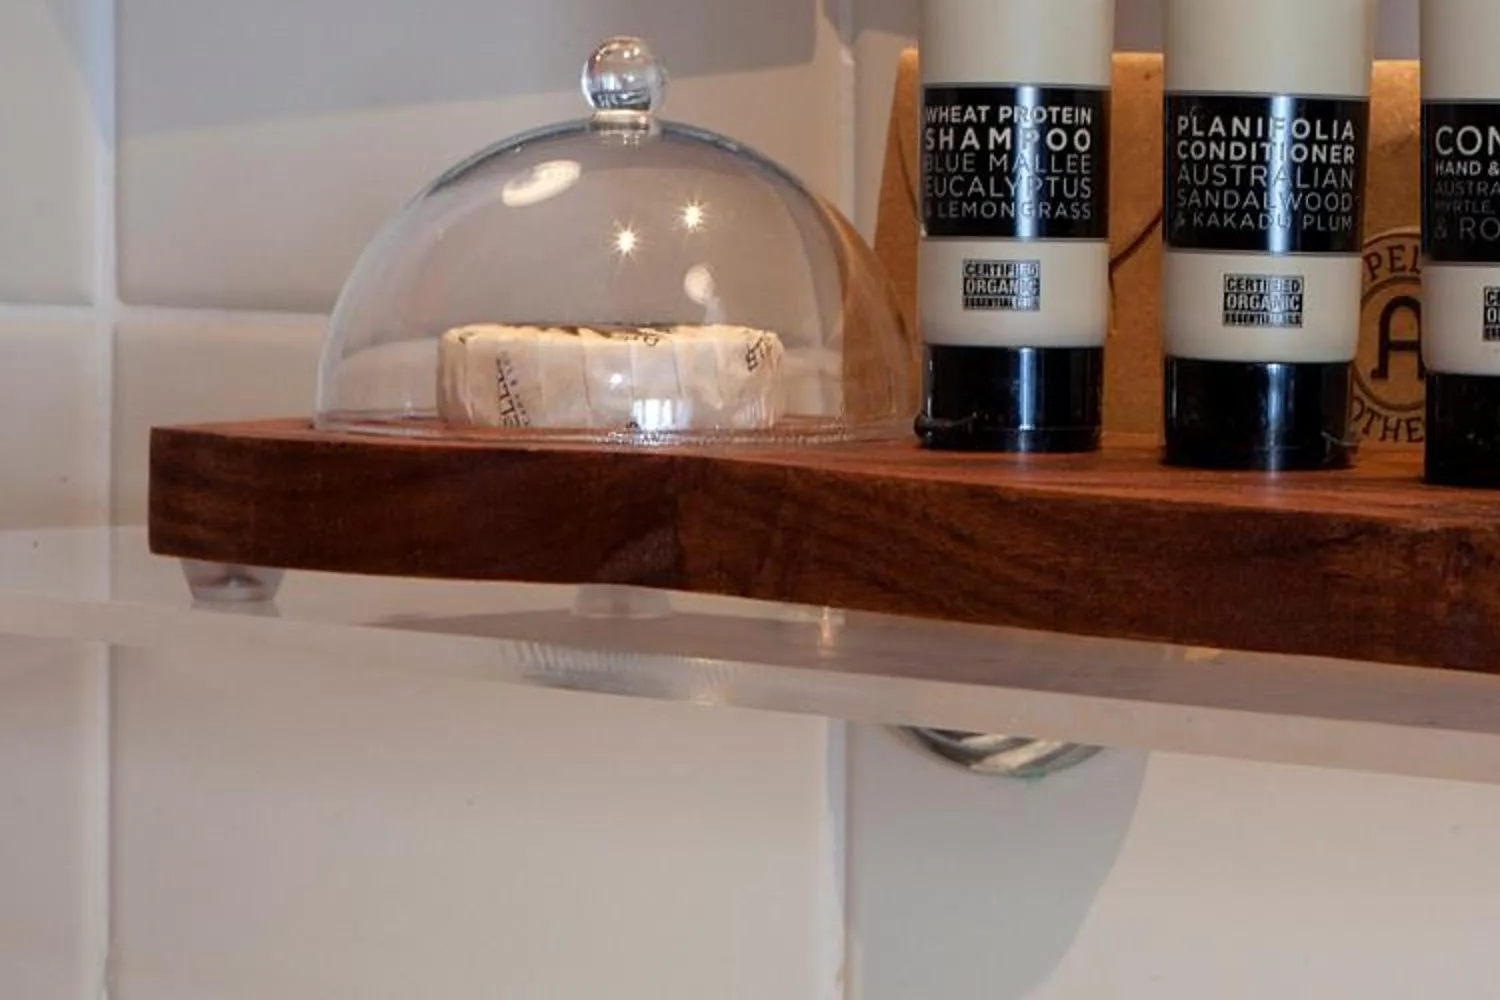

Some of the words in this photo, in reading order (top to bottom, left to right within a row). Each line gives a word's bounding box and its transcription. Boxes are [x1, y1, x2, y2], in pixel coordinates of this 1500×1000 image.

[926, 105, 990, 124] WHEAT
[999, 105, 1092, 125] PROTEIN
[1177, 115, 1355, 141] PLANIFOLIA
[925, 127, 1091, 151] SHAMPOO
[1177, 141, 1355, 164] CONDITIONER
[989, 153, 1091, 174] MALLEE
[1435, 161, 1481, 176] HAND
[1488, 161, 1500, 176] &
[1177, 164, 1354, 189] AUSTRALIAN
[926, 176, 1091, 199] EUCALYPTUS
[937, 201, 1091, 220] LEMONGRASS
[1177, 189, 1352, 212] SANDALWOOD
[1193, 212, 1291, 230] KAKADU
[1303, 215, 1352, 231] PLUM
[966, 279, 1039, 296] ORGANIC
[1227, 293, 1300, 311] ORGANIC
